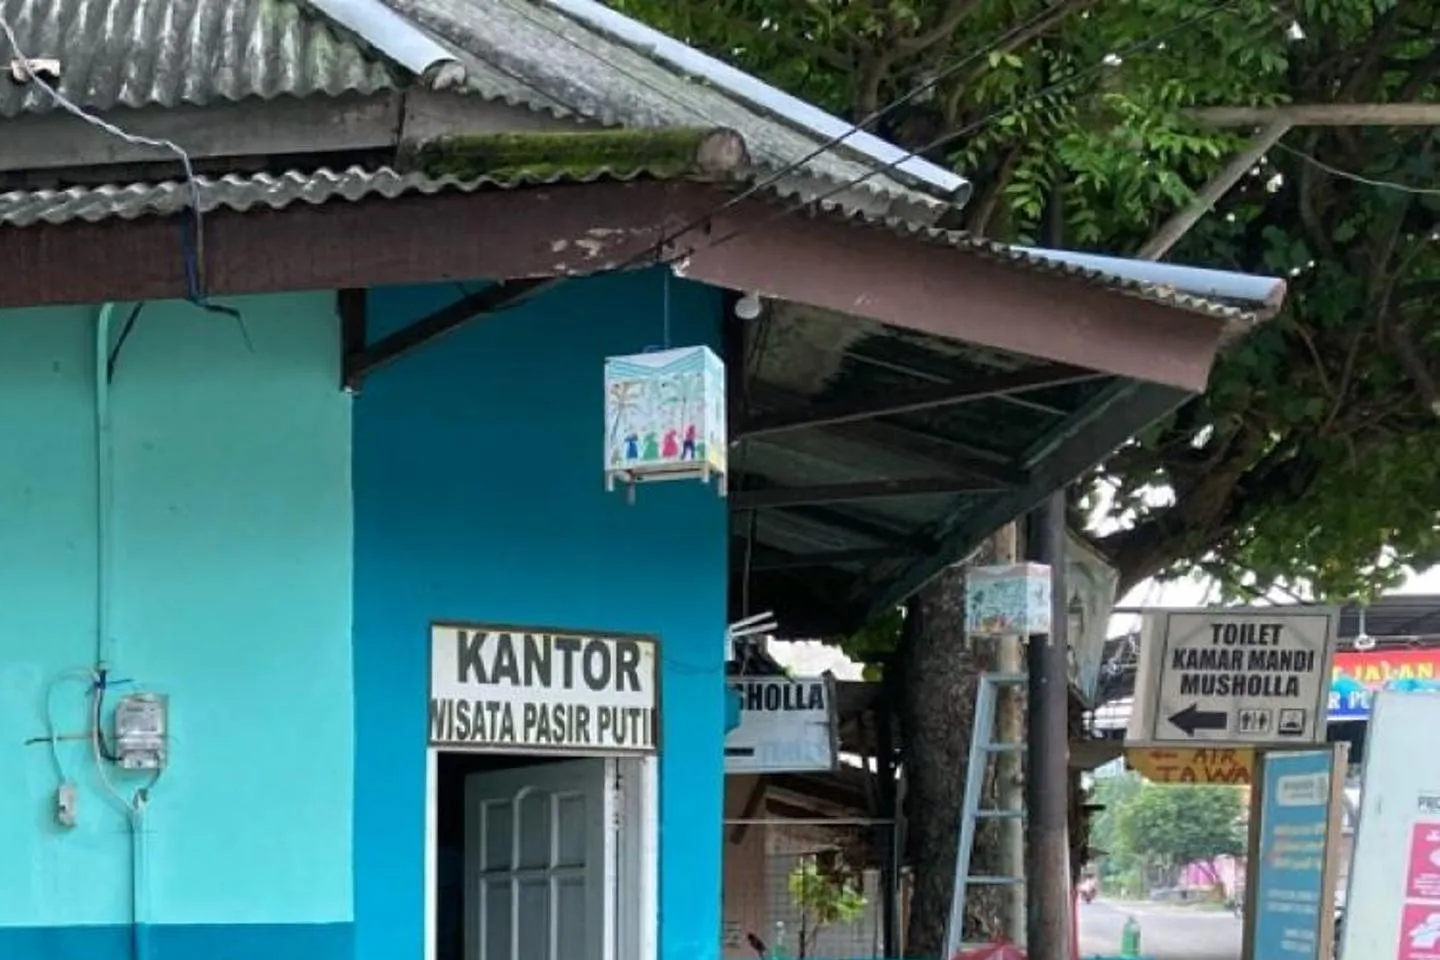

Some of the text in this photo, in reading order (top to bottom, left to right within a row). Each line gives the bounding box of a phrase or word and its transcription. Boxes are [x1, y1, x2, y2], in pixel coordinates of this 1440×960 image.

[1211, 623, 1283, 646] TOILET
[457, 630, 642, 692] KANTOR
[1171, 649, 1315, 673] KAMAR MANDI
[1179, 673, 1300, 697] MUSHOLLA
[523, 702, 590, 744] PASIR
